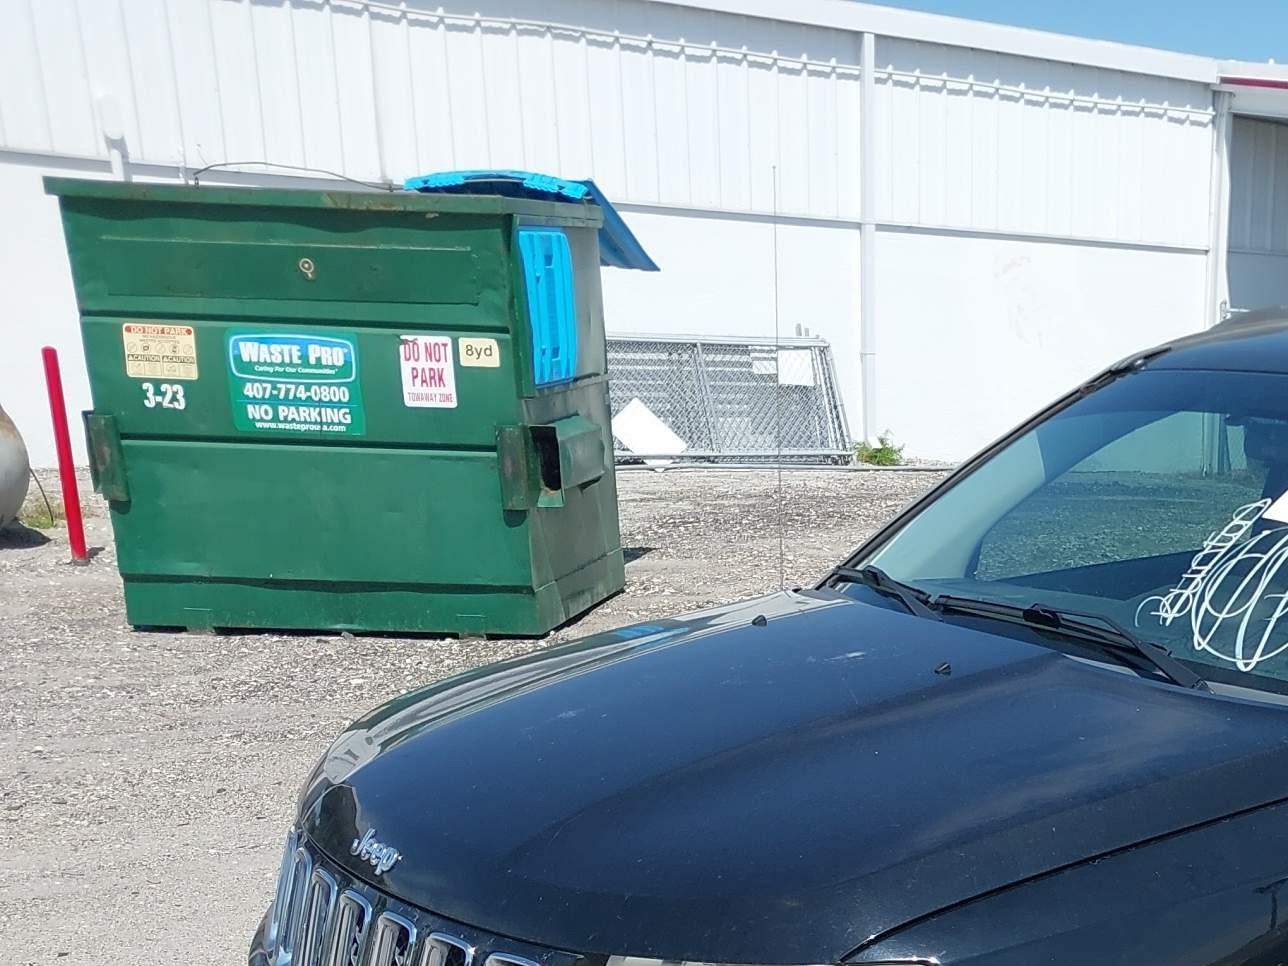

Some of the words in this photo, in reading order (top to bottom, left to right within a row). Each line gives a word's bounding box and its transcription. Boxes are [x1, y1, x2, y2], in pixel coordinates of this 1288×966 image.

[130, 326, 144, 334] DO
[239, 341, 302, 364] WASTE
[308, 344, 345, 367] PRO
[403, 342, 420, 362] DO
[424, 342, 449, 363] NOT
[465, 344, 493, 360] 8yd
[254, 365, 274, 373] Caring
[411, 367, 446, 388] PARK
[142, 382, 186, 410] 3-23
[243, 382, 350, 403] 407-774-0800
[438, 393, 454, 403] ZONE
[246, 404, 273, 420] NO
[278, 405, 352, 424] PARKING
[349, 828, 400, 876] Jeep
